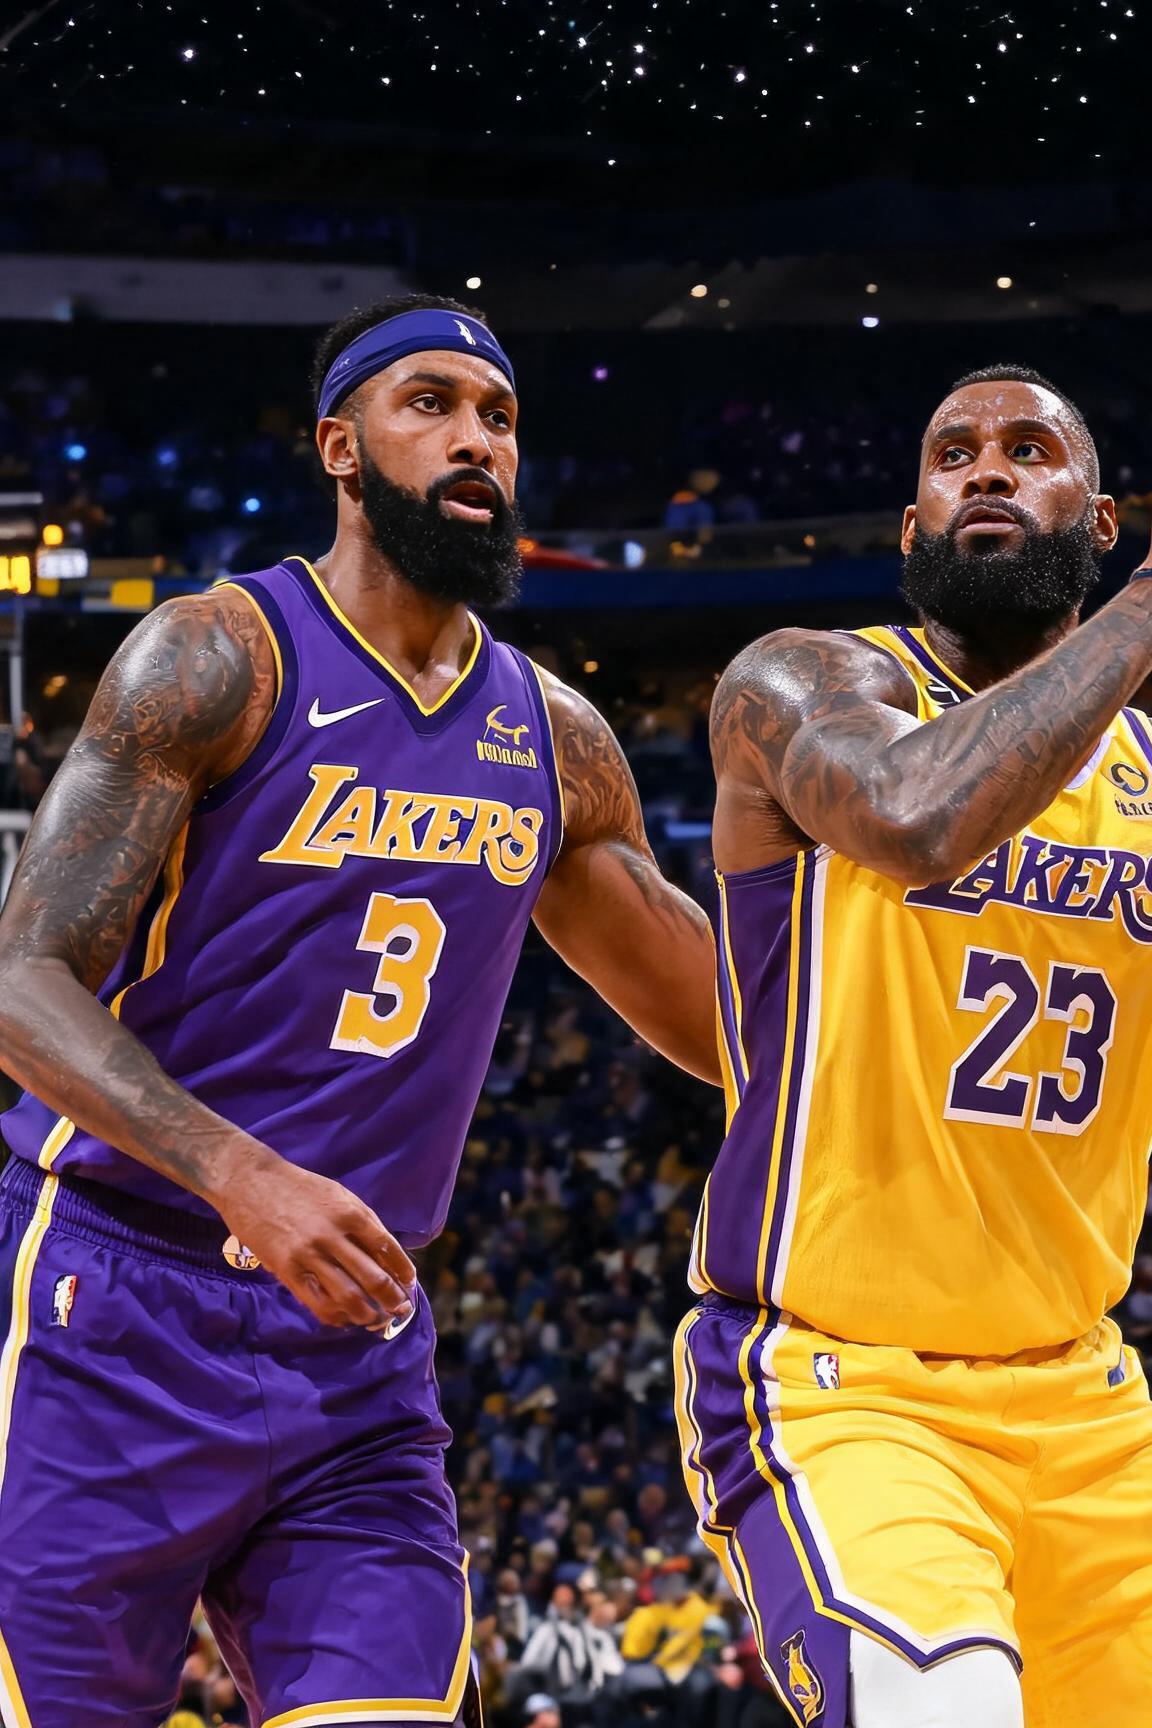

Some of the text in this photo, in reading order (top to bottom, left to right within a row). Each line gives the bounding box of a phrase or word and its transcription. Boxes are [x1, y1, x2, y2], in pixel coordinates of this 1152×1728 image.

[258, 764, 543, 886] LAKERS
[329, 892, 447, 1058] 3
[943, 945, 1118, 1137] 23
